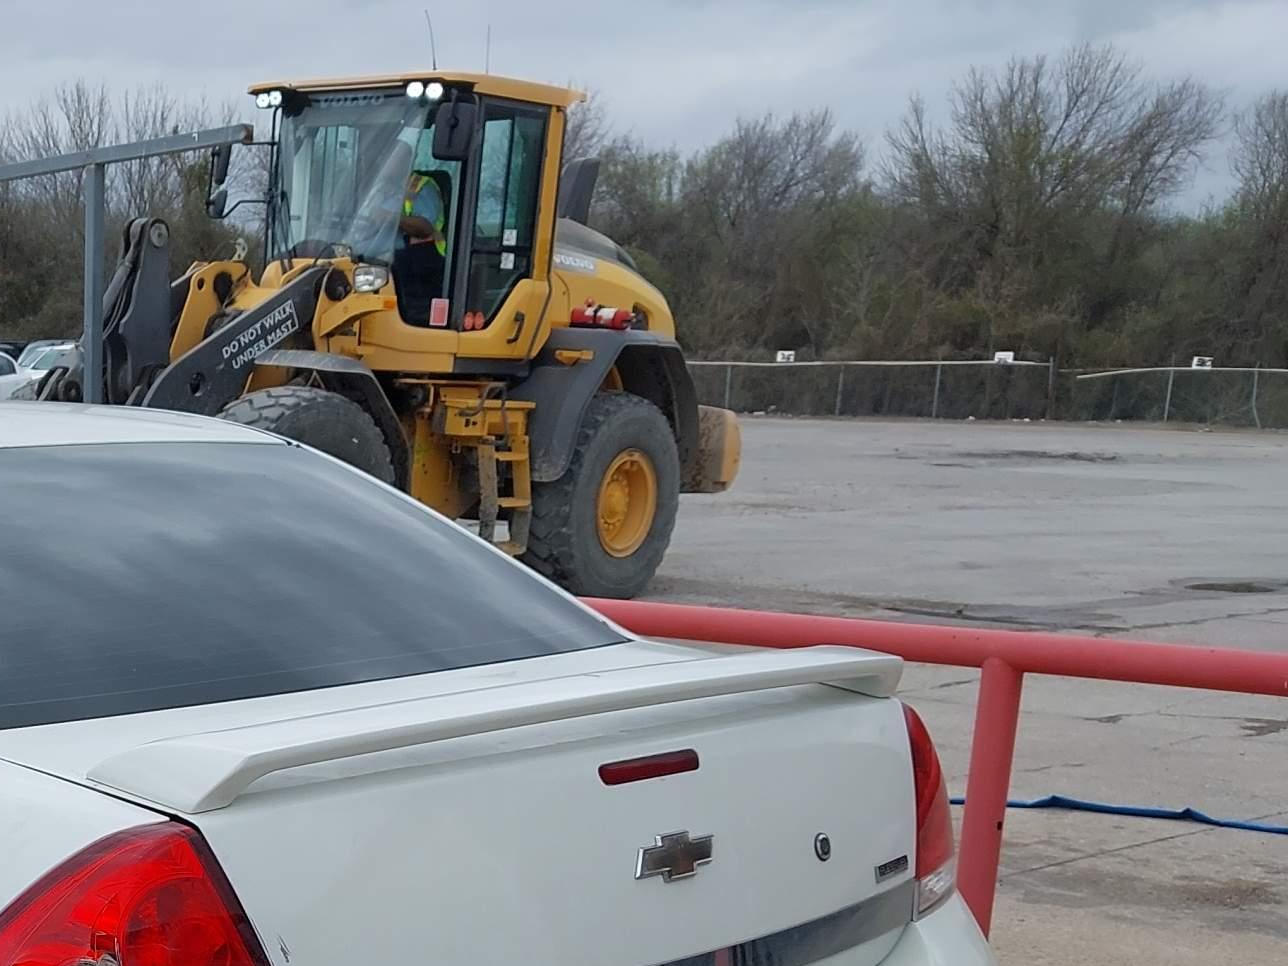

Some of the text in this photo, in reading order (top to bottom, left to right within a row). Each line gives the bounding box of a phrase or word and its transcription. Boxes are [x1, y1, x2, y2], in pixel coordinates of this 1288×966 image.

[222, 305, 294, 359] DO NOT WALK
[231, 319, 294, 369] UNDER MAST
